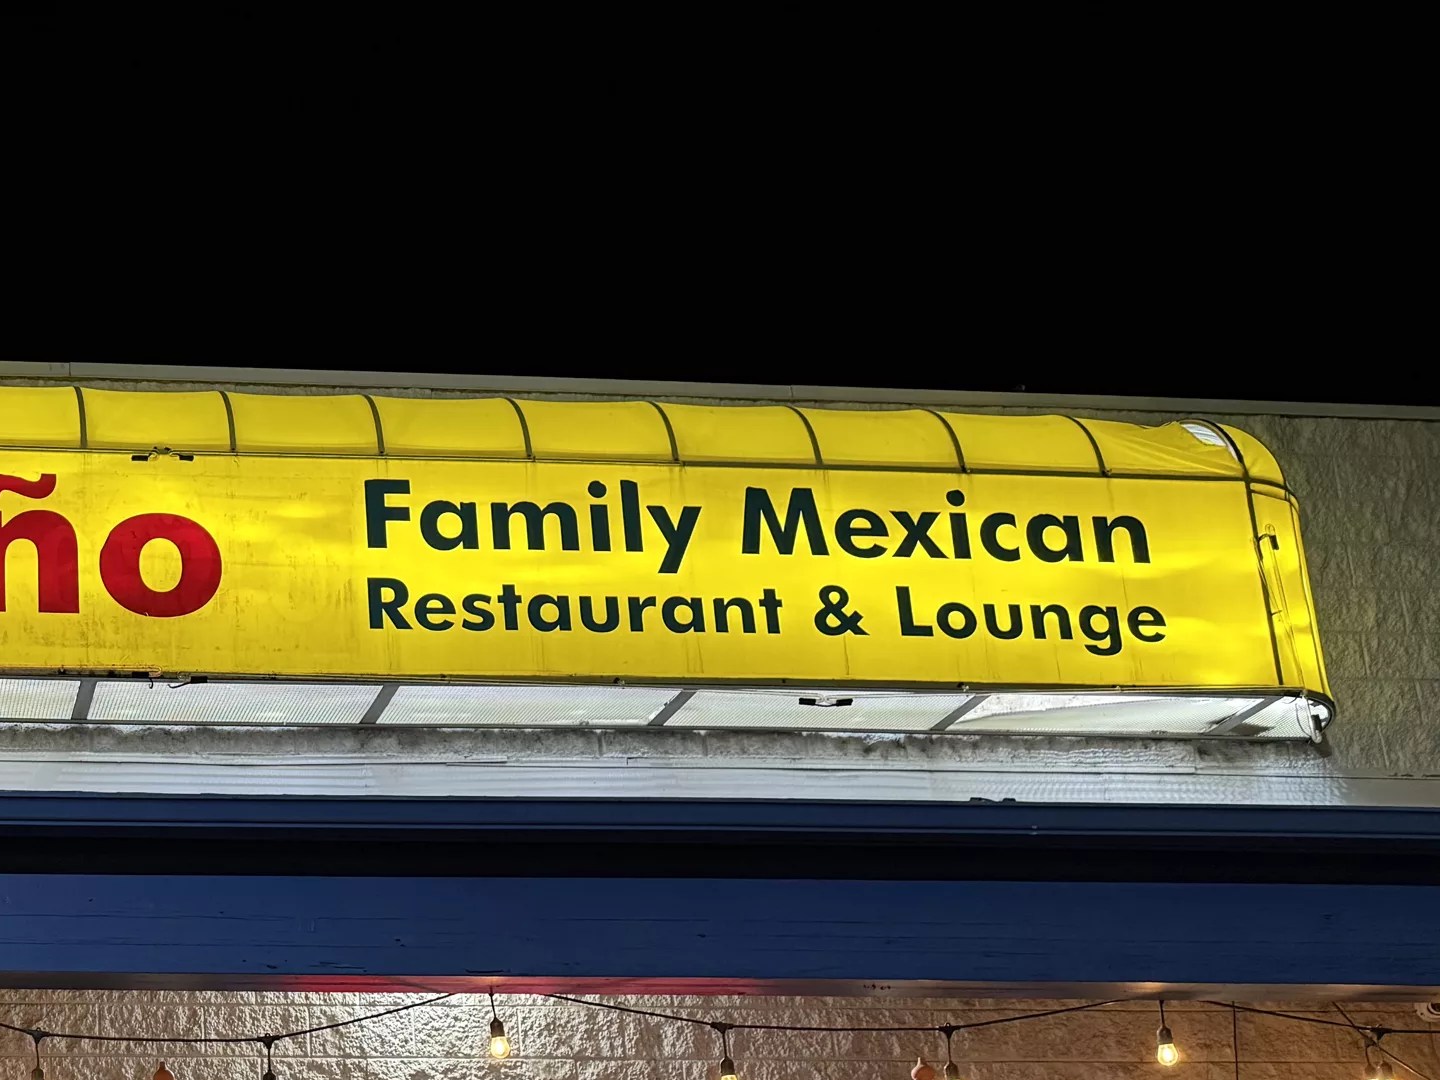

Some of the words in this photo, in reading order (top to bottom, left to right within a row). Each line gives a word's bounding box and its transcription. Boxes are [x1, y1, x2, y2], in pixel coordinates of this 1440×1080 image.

[364, 477, 701, 574] Family
[741, 486, 1151, 564] Mexican
[367, 577, 782, 635] Restaurant
[814, 584, 869, 637] &
[900, 585, 1167, 656] Lounge
